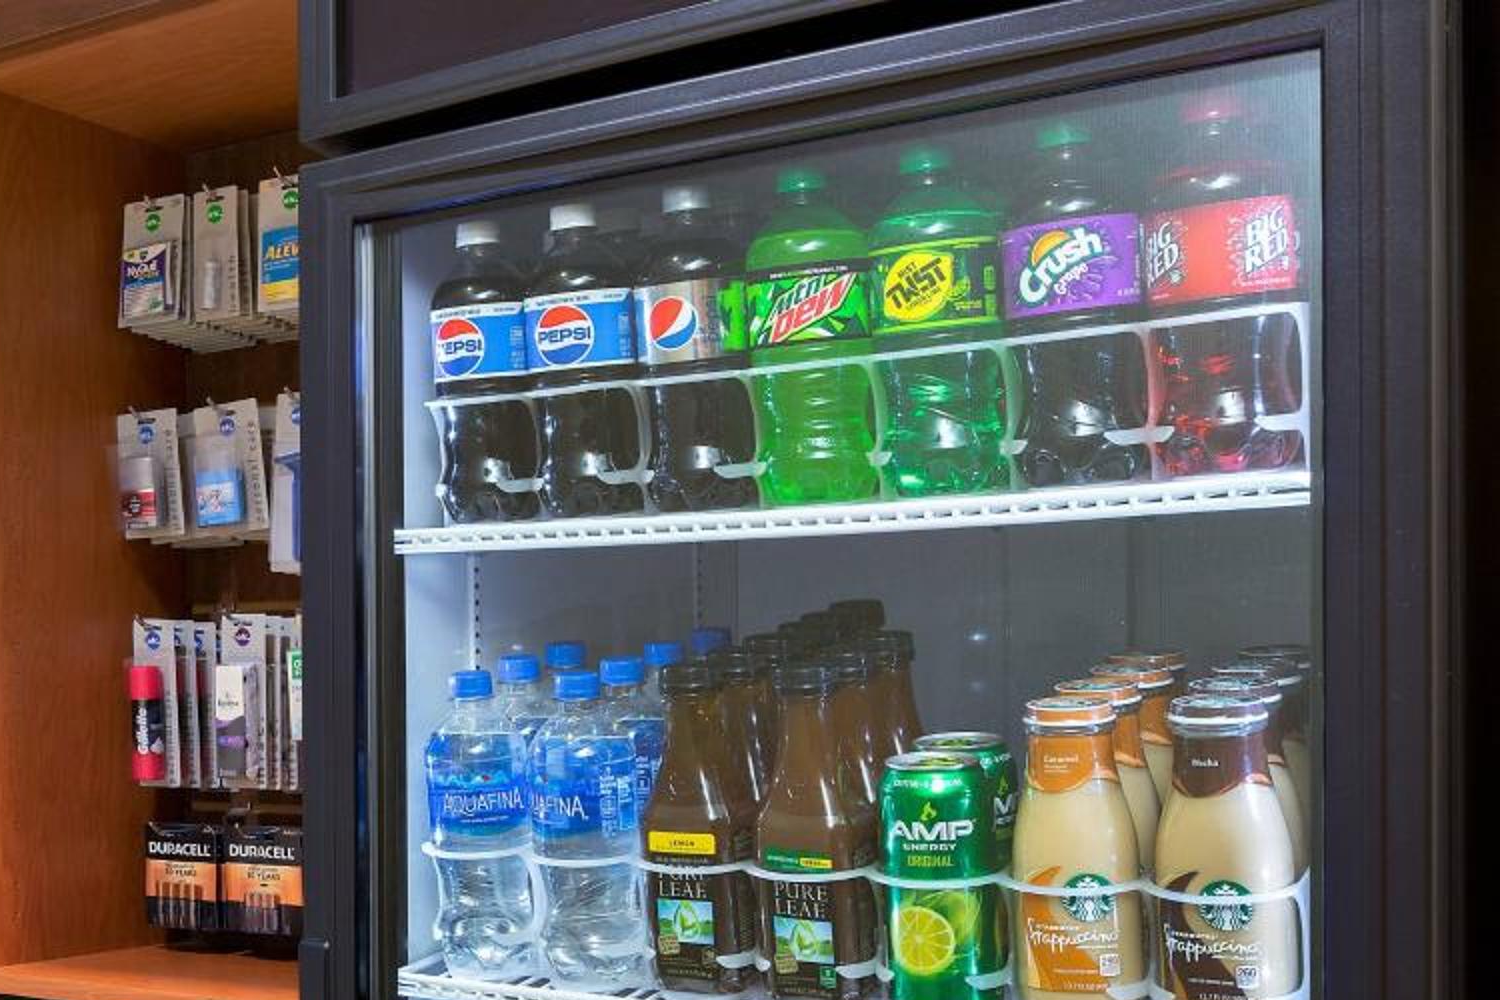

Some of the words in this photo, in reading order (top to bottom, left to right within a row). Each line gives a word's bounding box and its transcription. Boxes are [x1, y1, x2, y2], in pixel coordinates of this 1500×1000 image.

[264, 242, 299, 260] ALEV
[1019, 227, 1103, 303] Crush
[537, 326, 592, 345] PEPSI
[444, 787, 524, 818] AQUAFINA
[893, 820, 974, 841] AMP
[148, 841, 211, 857] DURACELL
[229, 843, 295, 860] DURACELL
[903, 843, 956, 852] ENERGY
[659, 882, 708, 898] LEAF
[774, 882, 828, 901] PURE
[775, 899, 826, 919] LEAF
[1027, 918, 1118, 954] Frappuccino
[1164, 923, 1260, 963] Frappuccino
